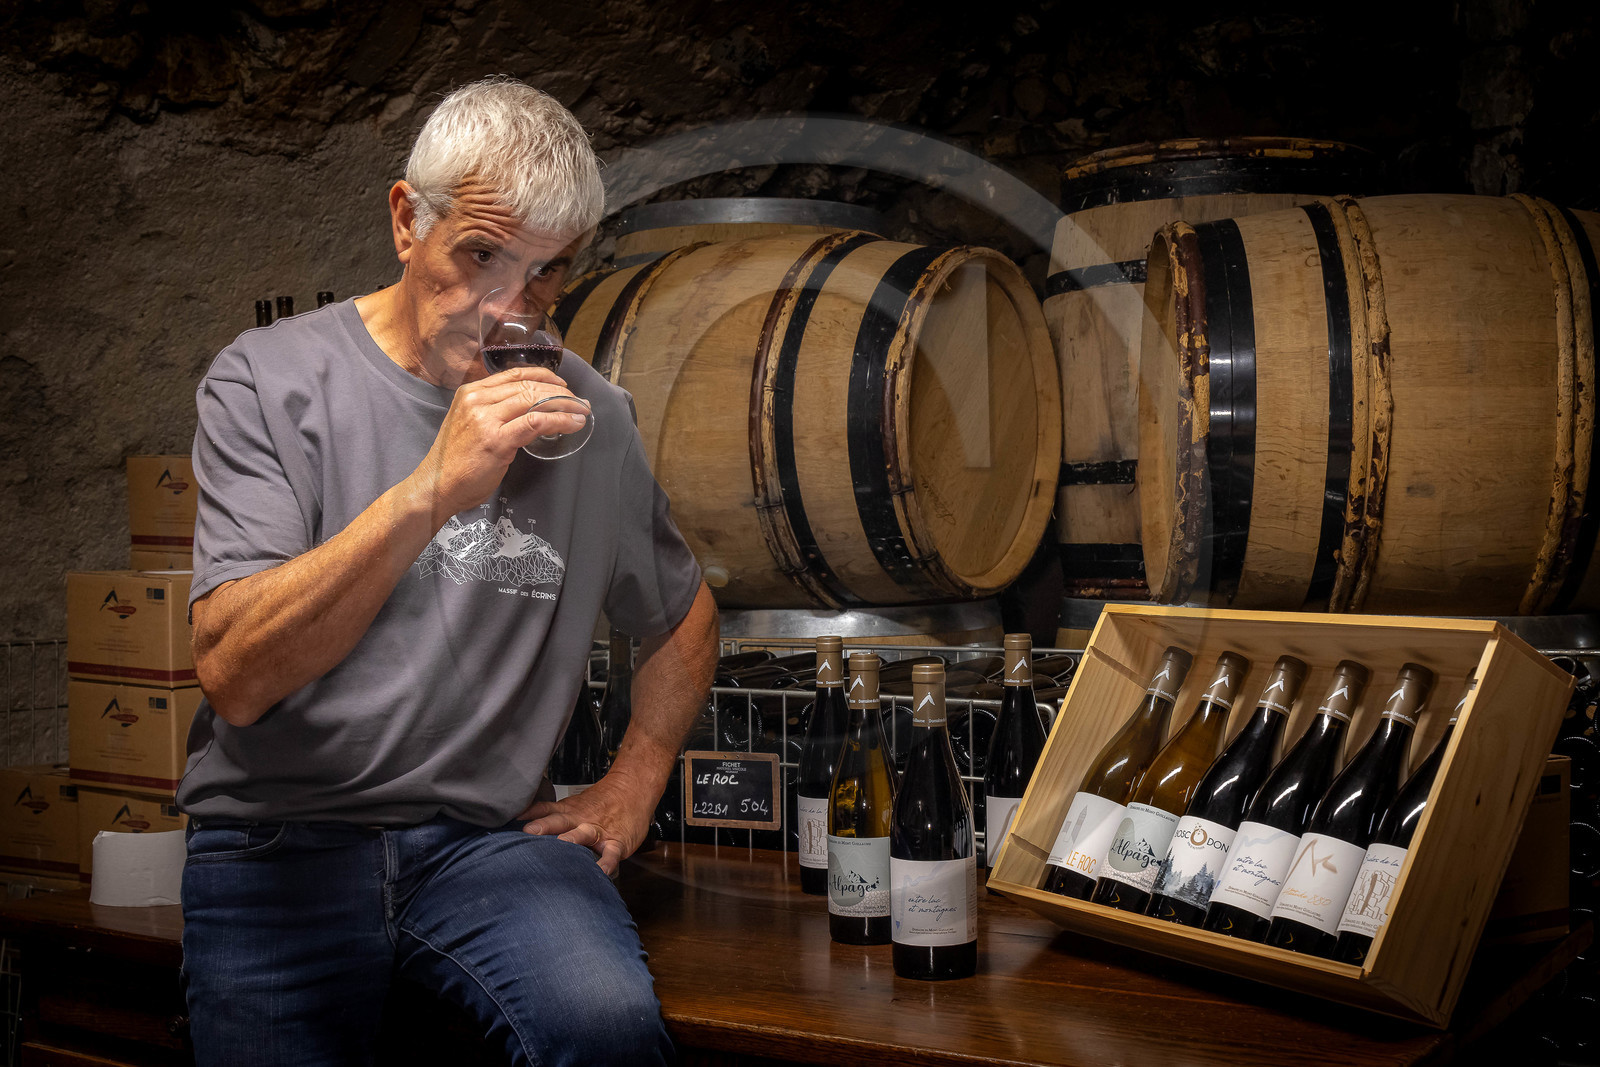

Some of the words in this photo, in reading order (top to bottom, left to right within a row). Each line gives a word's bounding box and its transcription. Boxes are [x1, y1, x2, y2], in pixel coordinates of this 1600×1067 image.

[531, 590, 556, 600] ÉCRINS
[740, 798, 768, 816] 504
[1066, 850, 1080, 866] LE
[1076, 854, 1096, 874] ROC
[928, 894, 942, 904] lac
[908, 904, 920, 912] et
[918, 905, 958, 922] montagnes
